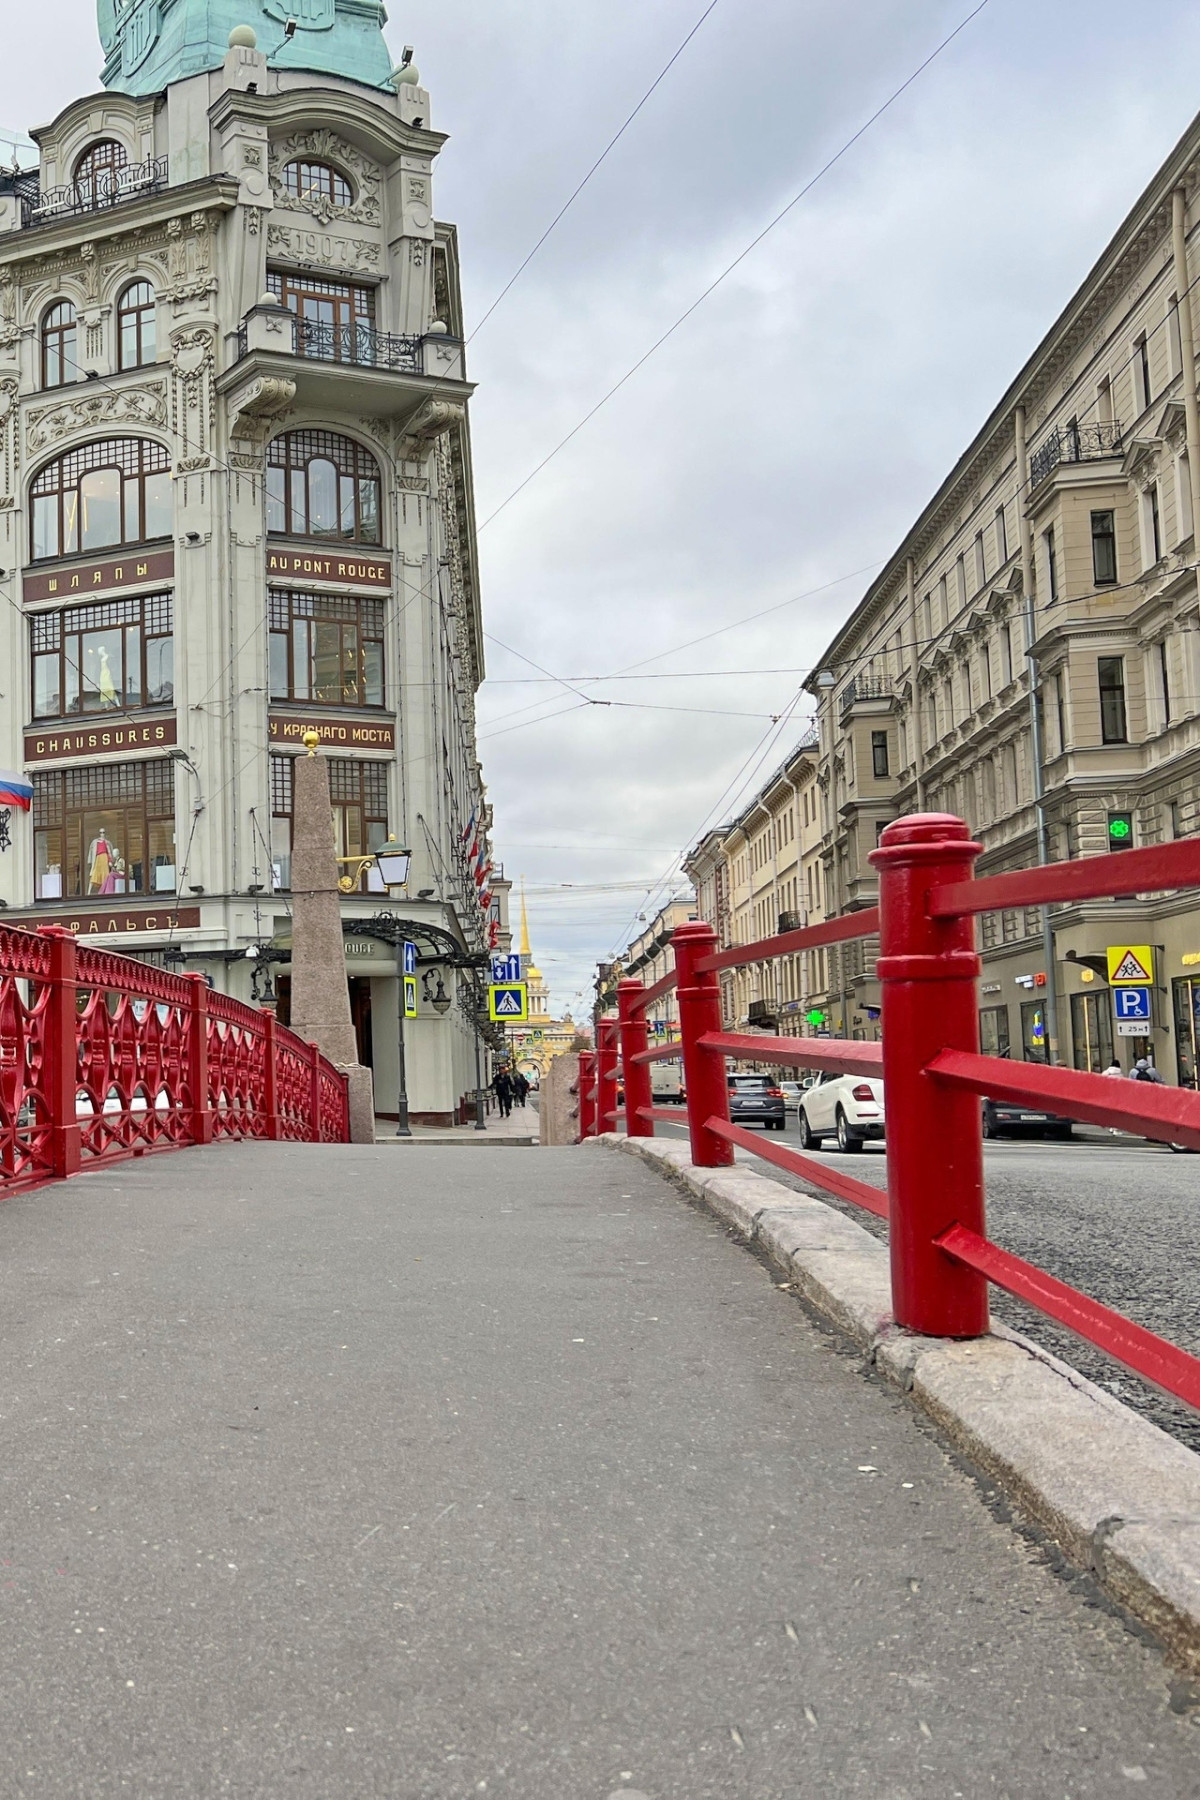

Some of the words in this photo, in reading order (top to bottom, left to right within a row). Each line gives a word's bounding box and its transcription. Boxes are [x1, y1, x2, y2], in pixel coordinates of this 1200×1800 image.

[296, 234, 348, 261] 1907
[48, 563, 149, 591] ШЛЯПЫ
[270, 556, 288, 569] AU
[293, 559, 331, 574] PONT
[338, 563, 386, 580] ROUGE
[36, 726, 166, 754] CHAUSSURES
[352, 728, 392, 743] МОСТА
[1121, 991, 1141, 1015] P
